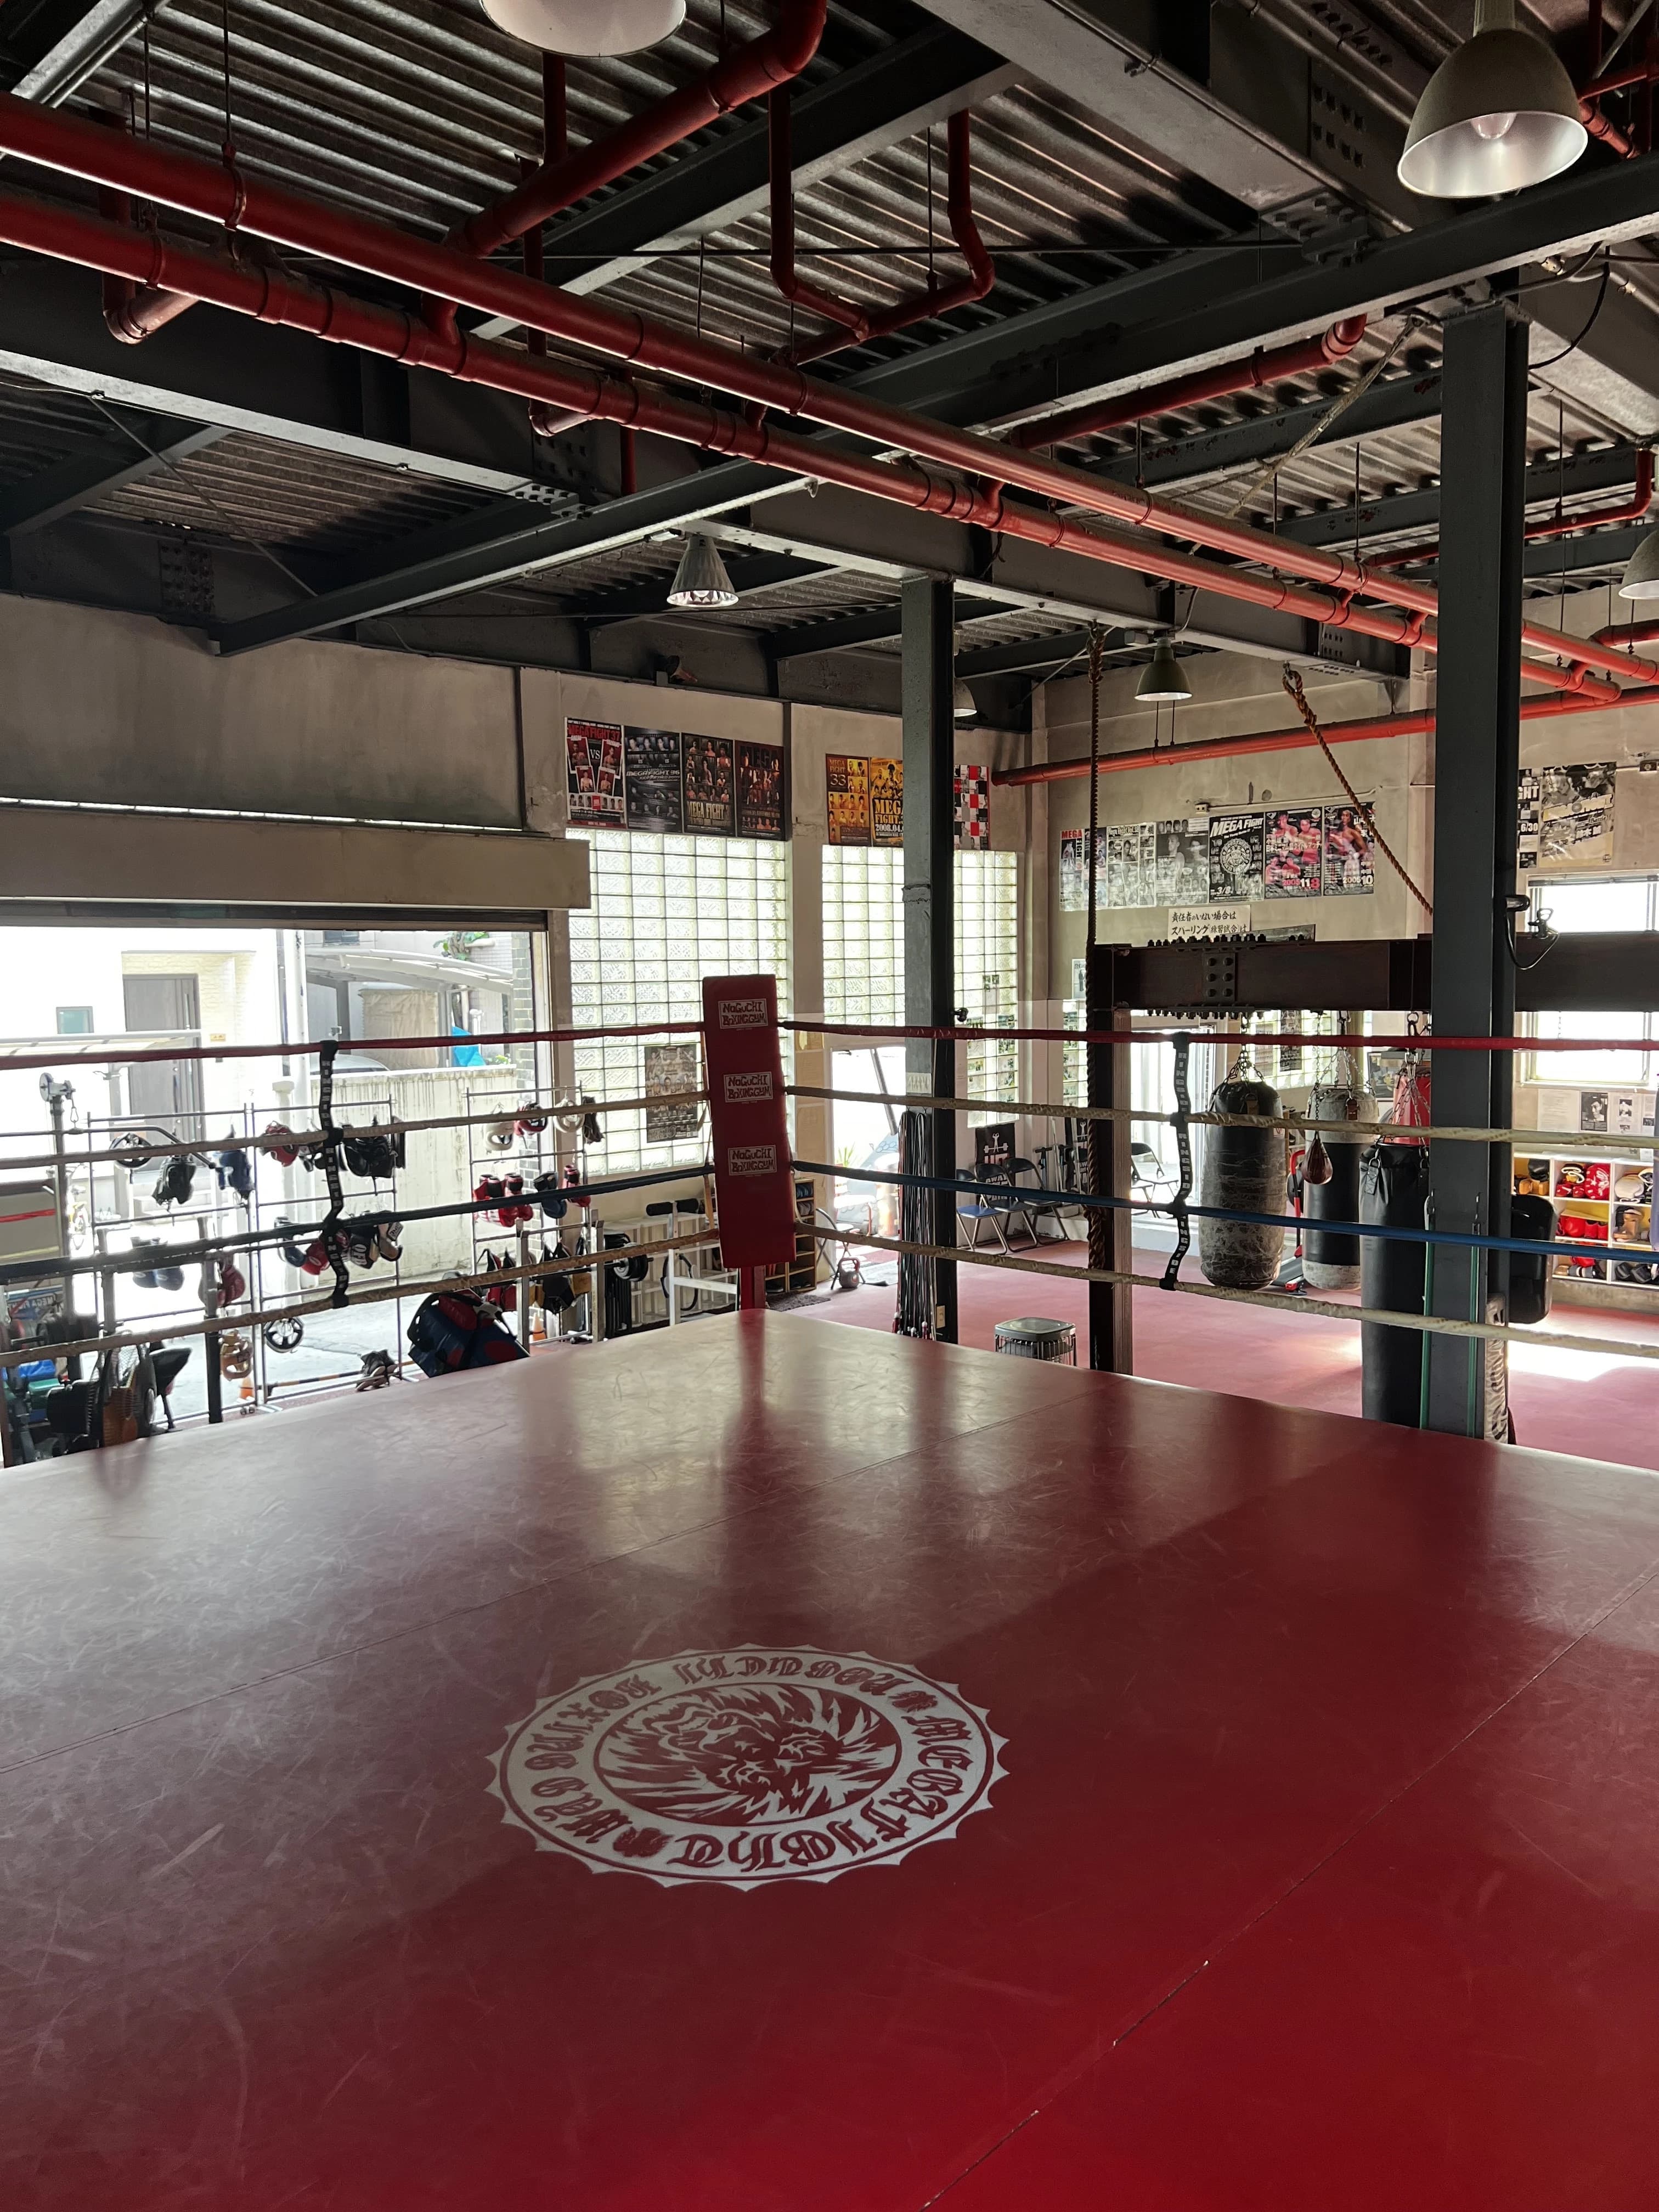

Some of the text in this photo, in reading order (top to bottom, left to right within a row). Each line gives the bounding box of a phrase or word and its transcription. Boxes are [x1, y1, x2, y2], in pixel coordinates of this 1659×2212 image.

[590, 749, 601, 760] VS
[830, 774, 847, 786] 33
[687, 800, 704, 818] MEGA
[706, 803, 725, 820] FIGHT
[874, 799, 904, 815] MEG
[1210, 820, 1243, 838] MEGA
[1243, 817, 1264, 829] FIGHT
[1520, 822, 1539, 832] 6/30
[1062, 829, 1082, 839] MEGA
[1300, 878, 1311, 888] 11
[1342, 876, 1362, 884] 2005
[1172, 910, 1237, 923] 責任者のいない場合は
[748, 1013, 766, 1023] GYM
[1175, 1052, 1189, 1112] RINGSIDE
[753, 1085, 771, 1097] GYM
[758, 1158, 775, 1170] GYM
